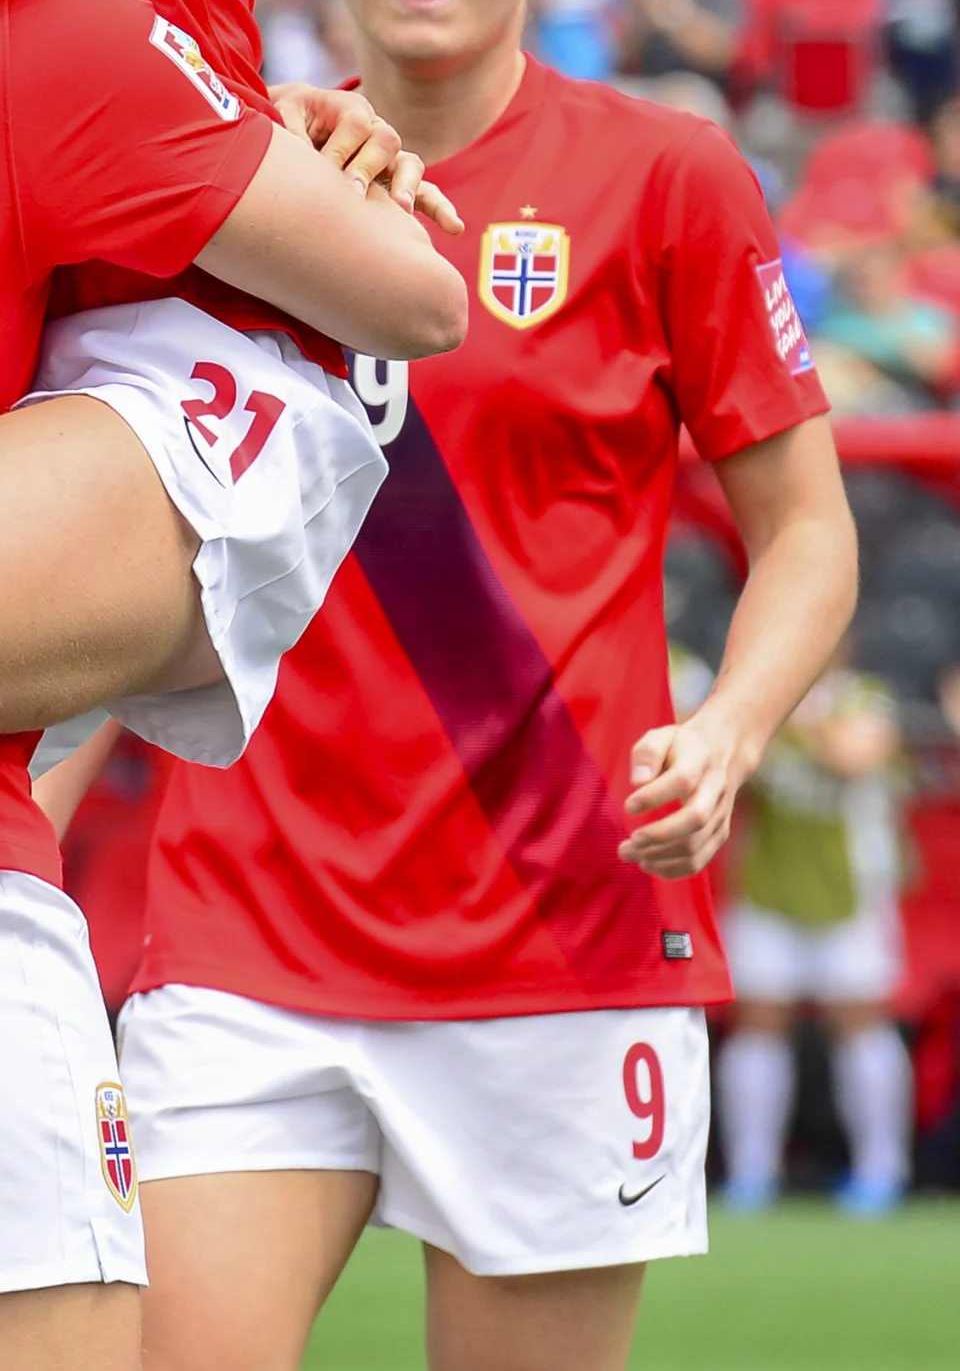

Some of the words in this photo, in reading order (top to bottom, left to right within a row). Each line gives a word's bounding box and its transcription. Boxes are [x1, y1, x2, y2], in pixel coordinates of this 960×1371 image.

[765, 271, 788, 311] LIV
[771, 298, 796, 337] YOU
[180, 361, 287, 485] 21
[623, 1041, 666, 1159] 9
